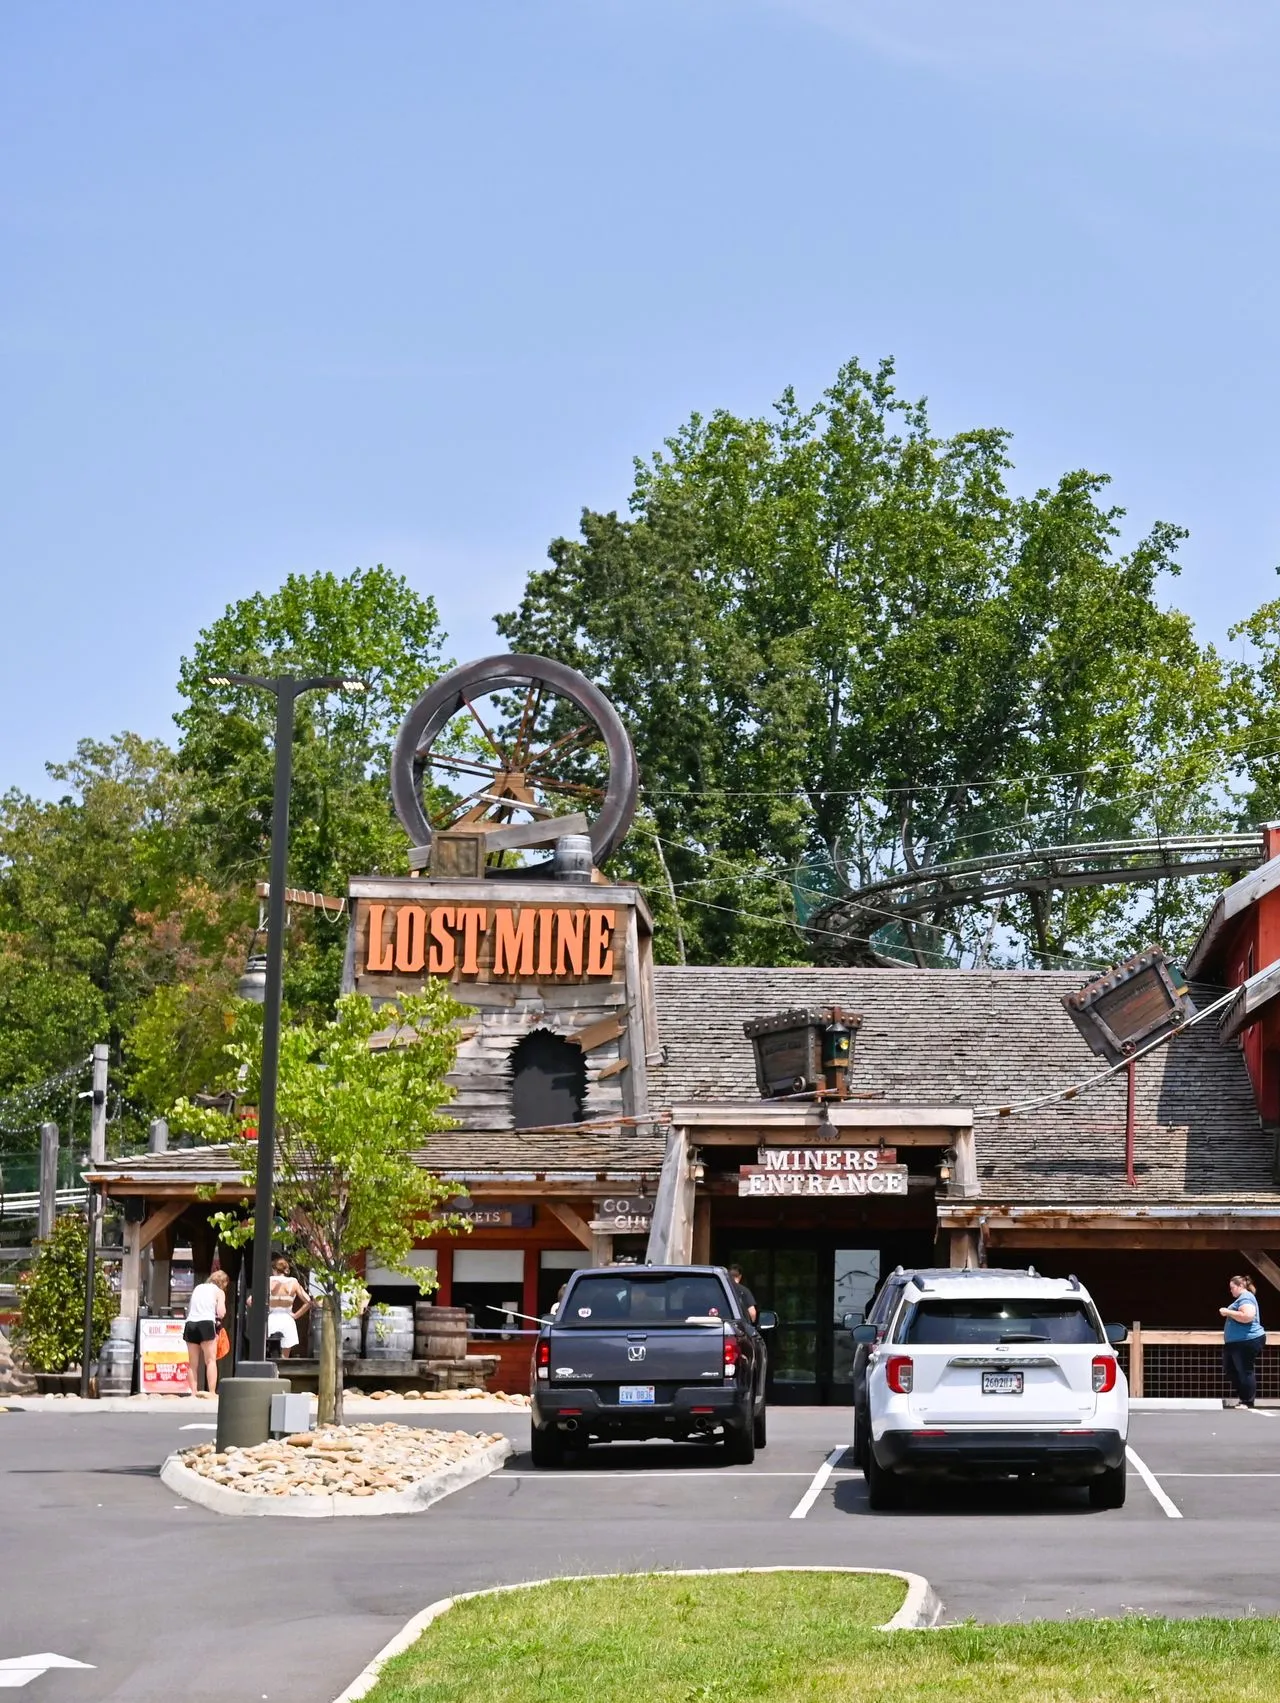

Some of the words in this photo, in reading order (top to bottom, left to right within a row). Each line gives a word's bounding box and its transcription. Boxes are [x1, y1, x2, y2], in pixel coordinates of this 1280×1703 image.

[366, 904, 487, 974] LOST
[493, 907, 616, 976] MINE
[764, 1150, 878, 1171] MINERS
[747, 1172, 903, 1195] ENTRANCE
